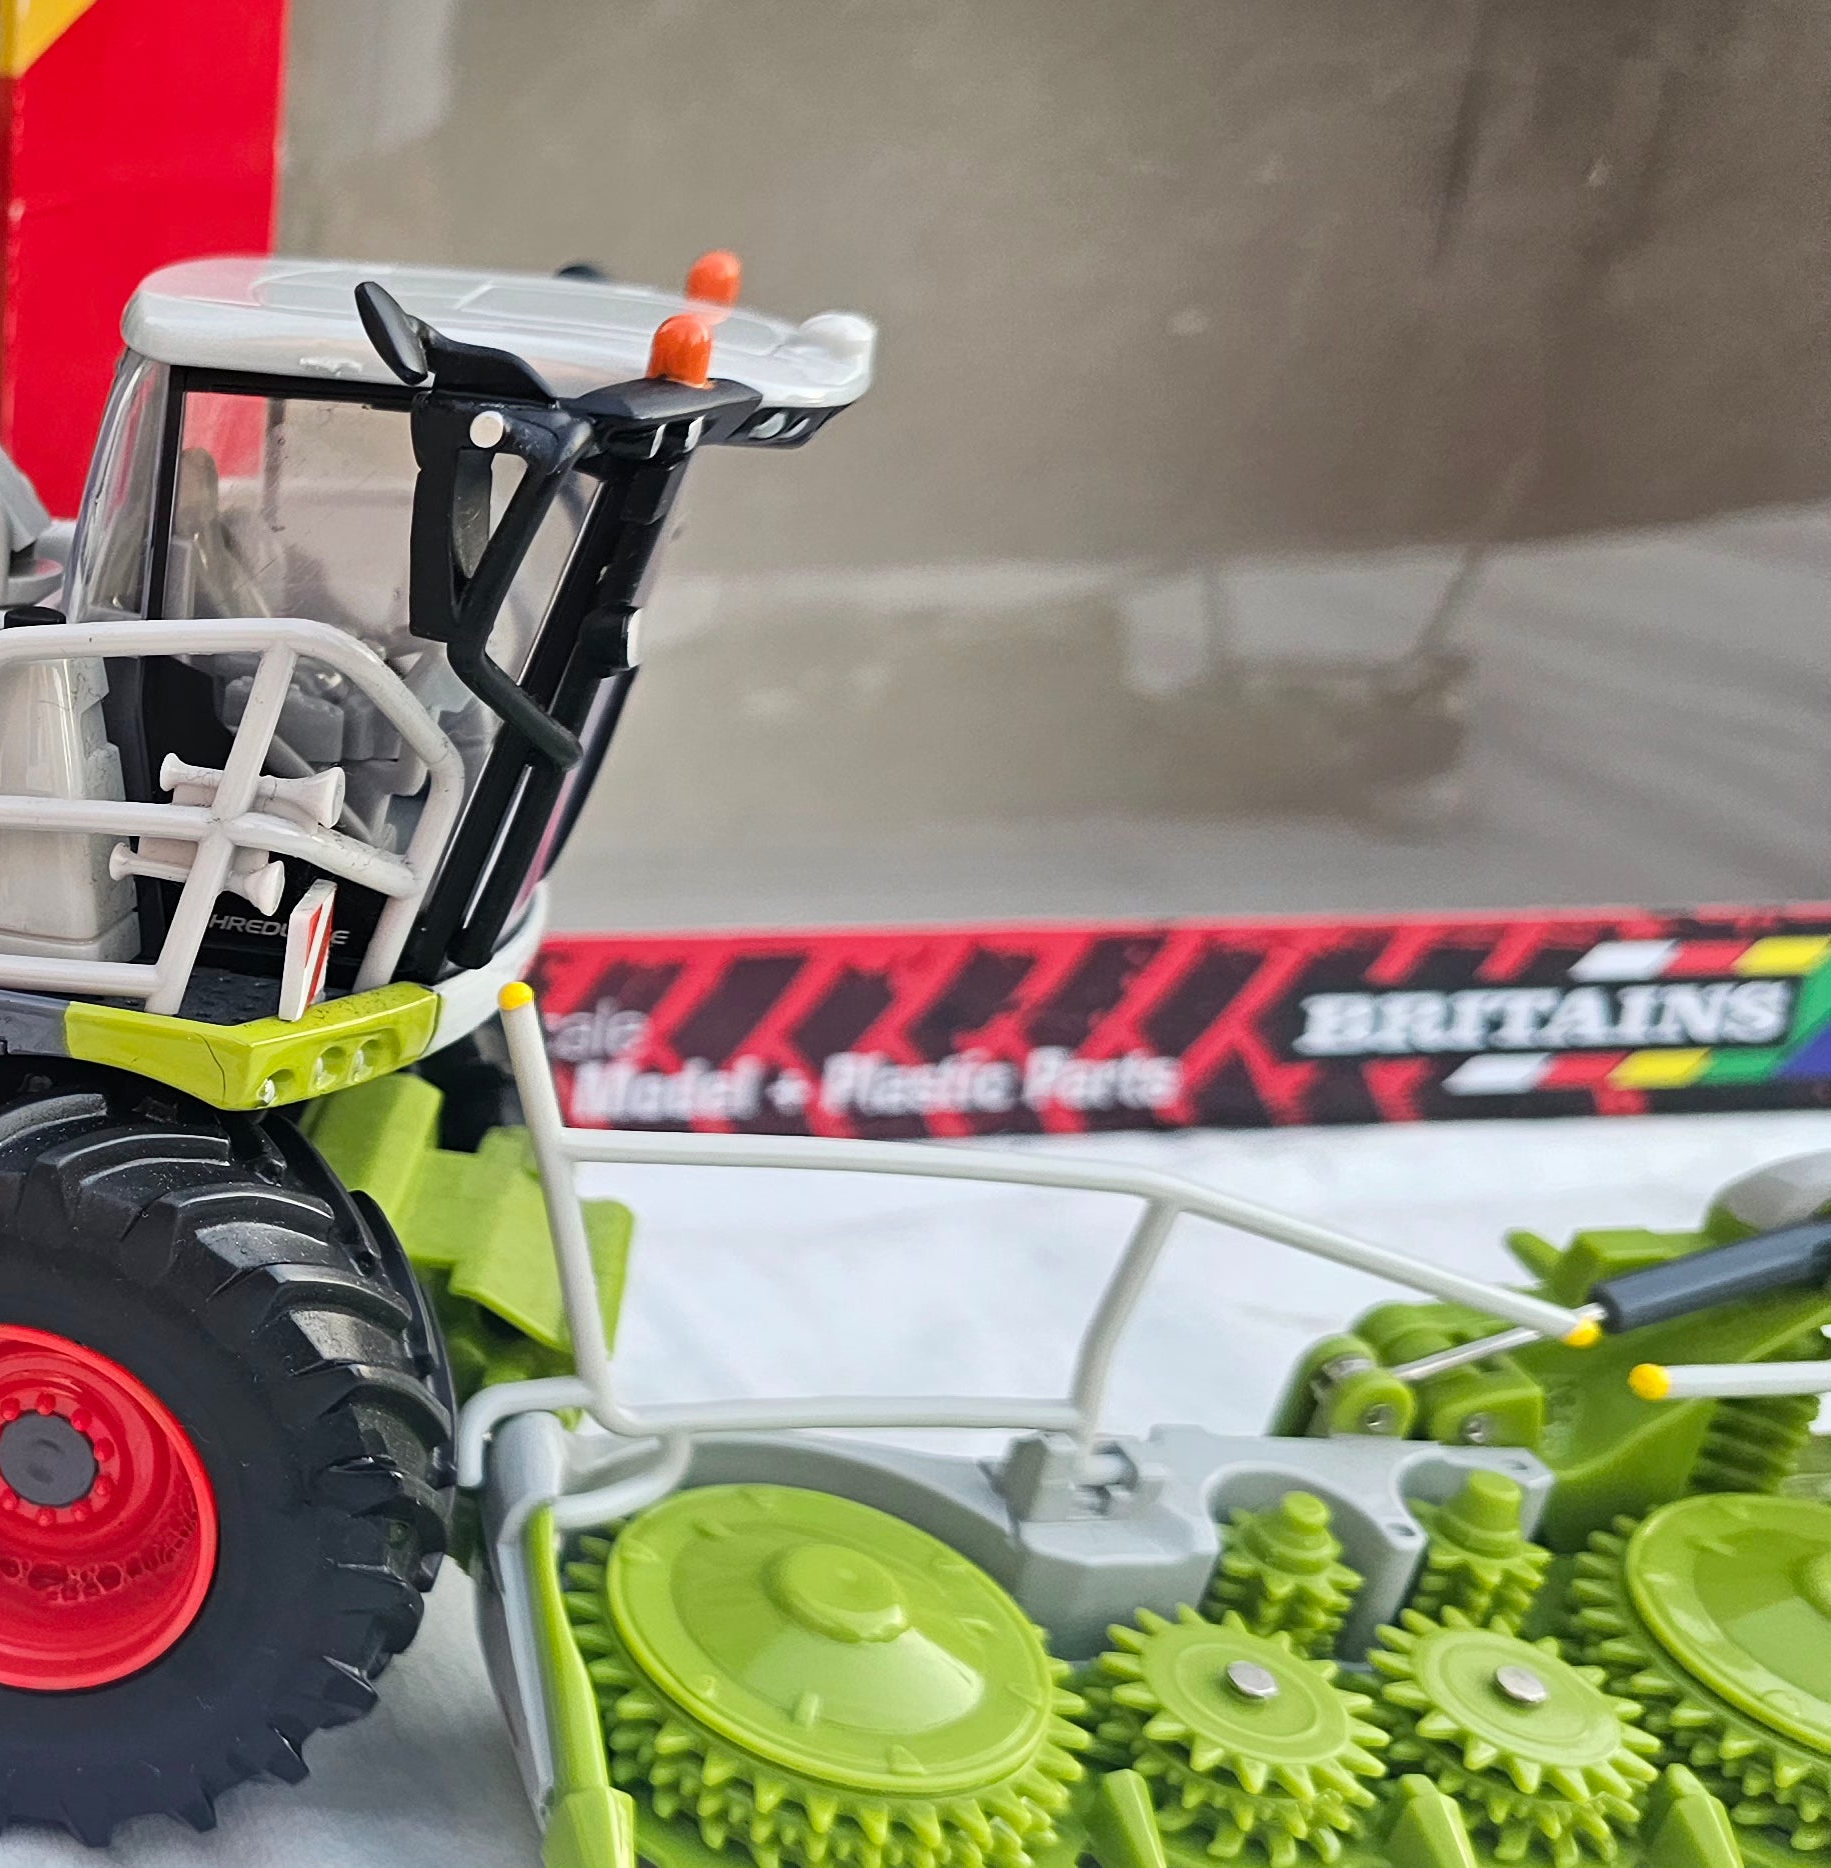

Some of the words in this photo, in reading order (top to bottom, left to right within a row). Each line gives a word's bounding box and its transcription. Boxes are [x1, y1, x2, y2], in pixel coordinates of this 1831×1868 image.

[1293, 979, 1792, 1055] BRITAINS
[820, 1047, 1016, 1116] Plastic
[1022, 1045, 1183, 1111] Parts
